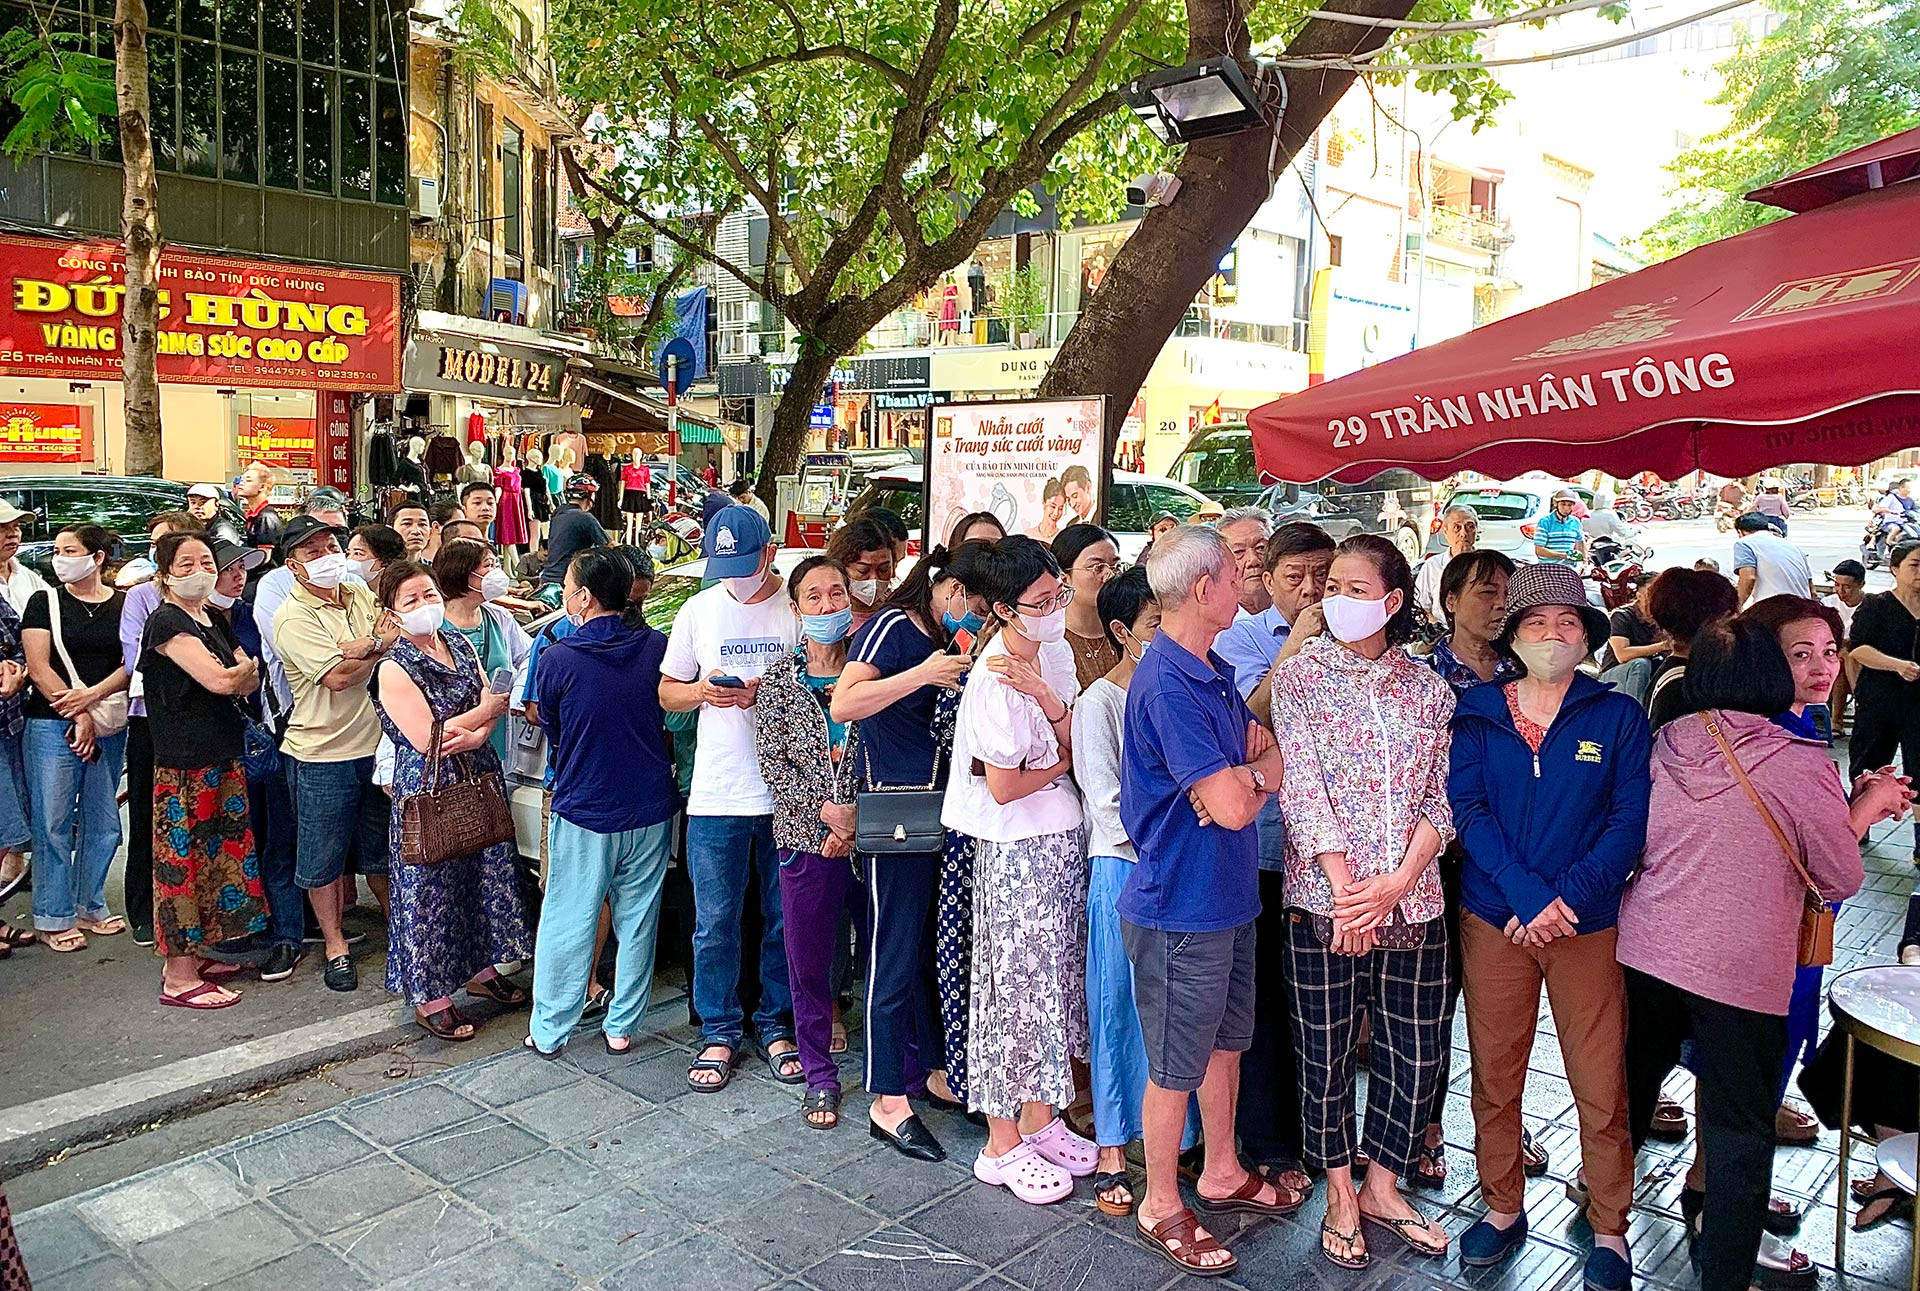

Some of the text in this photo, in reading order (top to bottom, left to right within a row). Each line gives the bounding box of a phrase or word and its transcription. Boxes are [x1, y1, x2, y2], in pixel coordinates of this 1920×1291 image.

[57, 256, 107, 271] CÔNG
[184, 267, 216, 282] BẢO
[219, 271, 242, 285] TÍN
[249, 274, 280, 288] ĐỨC
[286, 277, 325, 292] HÙNG
[186, 288, 369, 336] HÙNG
[40, 320, 349, 364] VÀNG ANG SÚC CAO CẤP
[1, 351, 23, 362] 26
[67, 355, 103, 367] NHÂN
[1001, 360, 1037, 373] DUNG
[227, 365, 251, 375] TEL:
[442, 347, 522, 389] MODEL
[528, 361, 552, 392] 24
[333, 399, 345, 414] GIA
[1327, 352, 1736, 449] 29 TRẦN NHÂN TÔNG
[330, 420, 349, 437] CÔNG
[978, 415, 1045, 436] Nhẫn cưới
[1159, 421, 1176, 431] 20
[333, 441, 347, 460] CHẾ
[944, 434, 1082, 456] & Trang sức cưới vàng
[1012, 461, 1035, 471] MINH
[1036, 459, 1059, 471] CHÂU
[334, 466, 347, 483] TÁC
[720, 643, 785, 655] EVOLUTION
